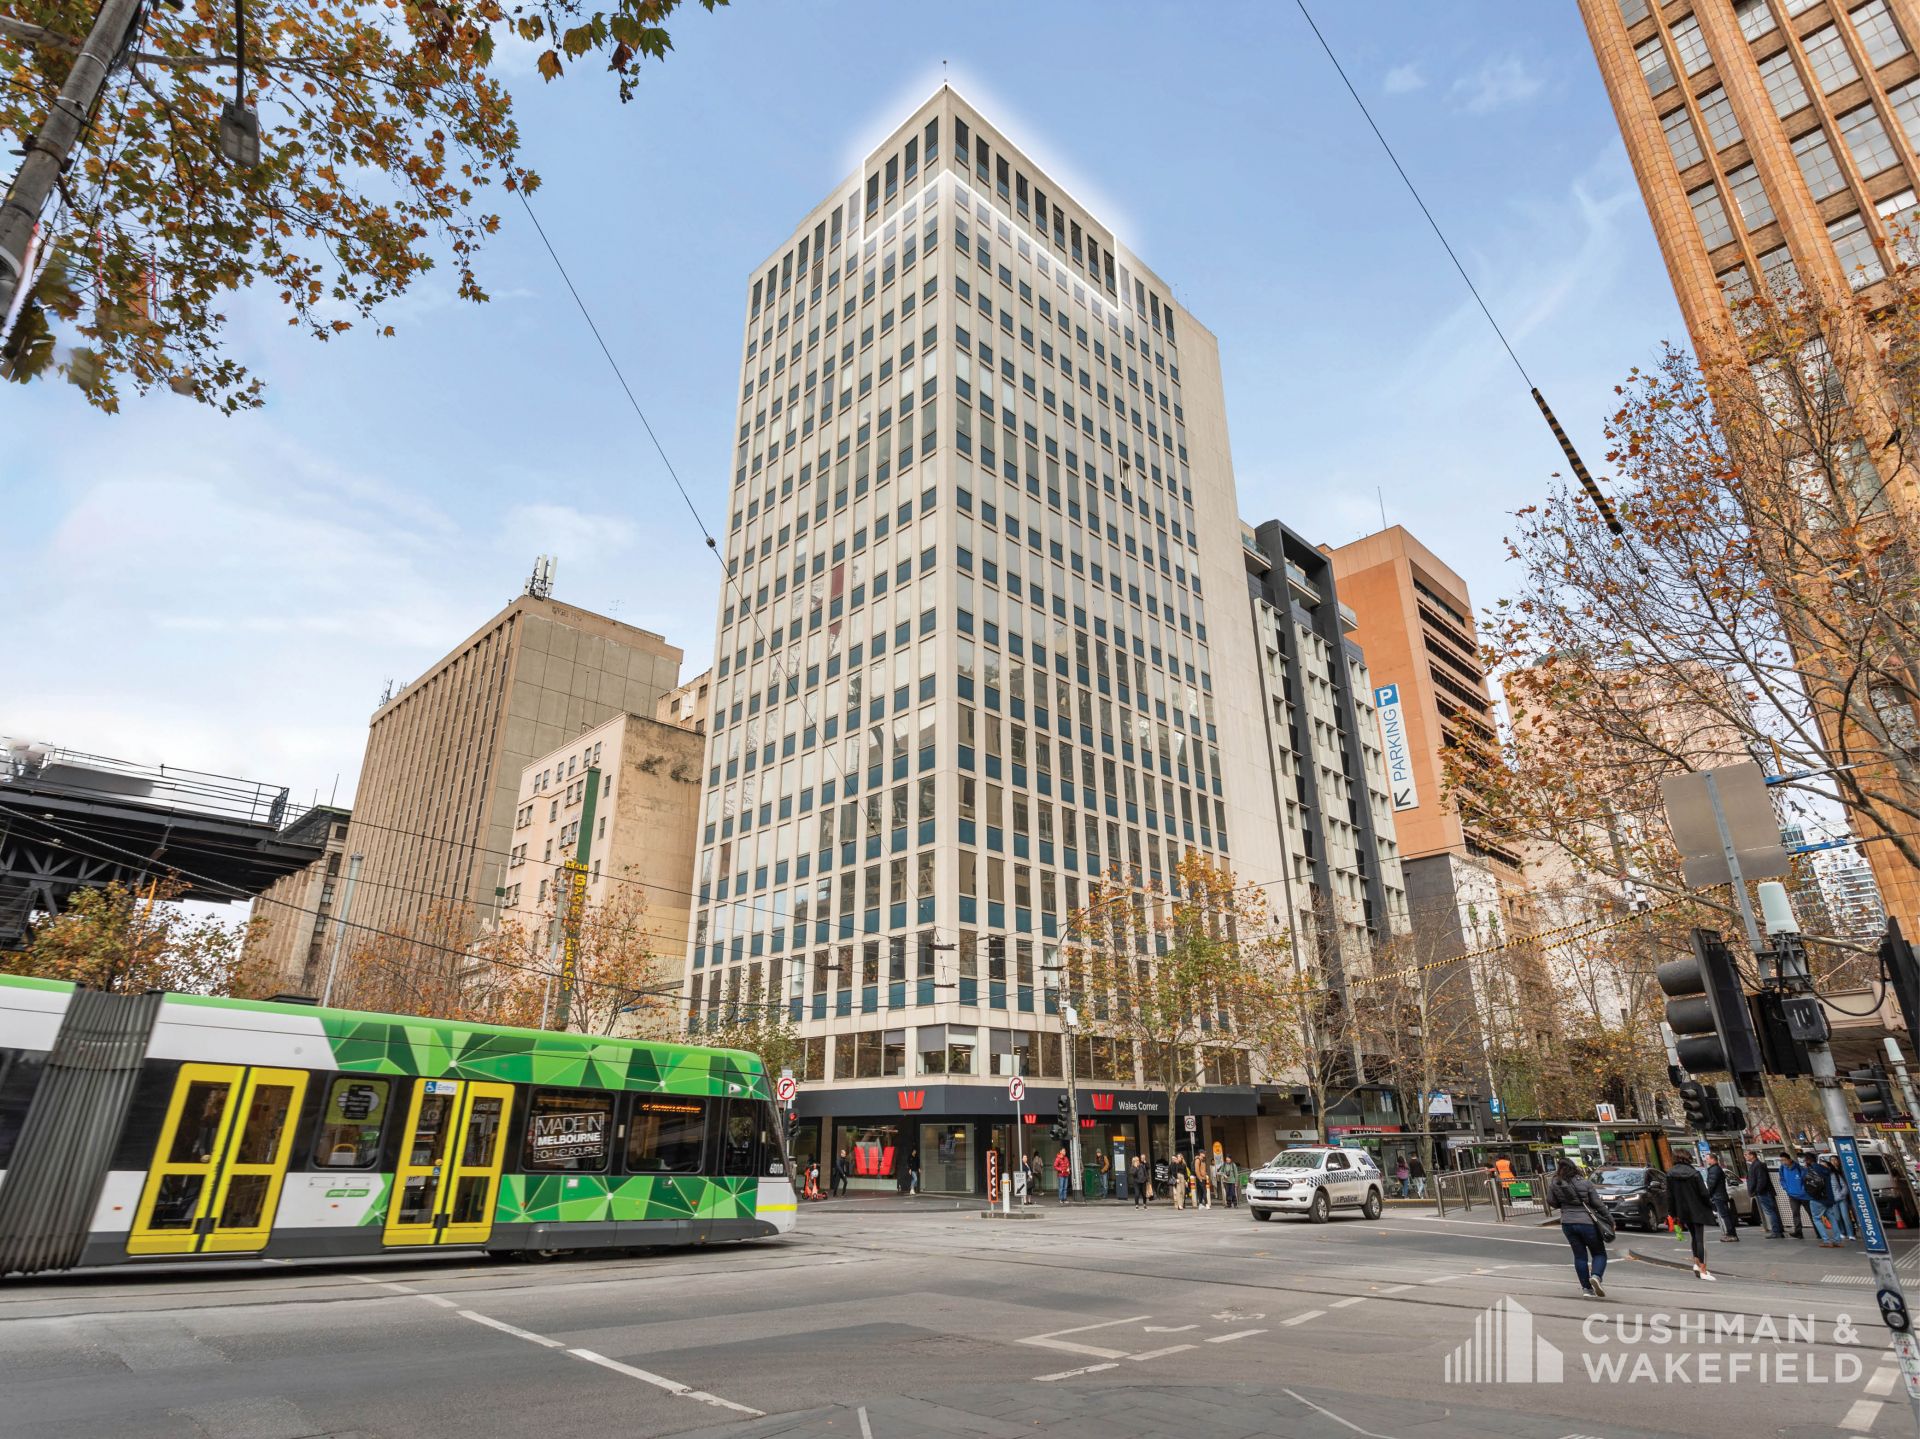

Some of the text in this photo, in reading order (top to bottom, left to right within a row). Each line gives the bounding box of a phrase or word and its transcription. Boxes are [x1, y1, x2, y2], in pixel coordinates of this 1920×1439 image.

[1379, 688, 1393, 706] P
[1383, 708, 1407, 782] PARKING
[1118, 1101, 1159, 1111] Wales Corner
[537, 1116, 586, 1136] MADE
[537, 1132, 601, 1146] MELBOURNE
[1851, 1182, 1863, 1192] St
[1857, 1193, 1877, 1237] Swanston
